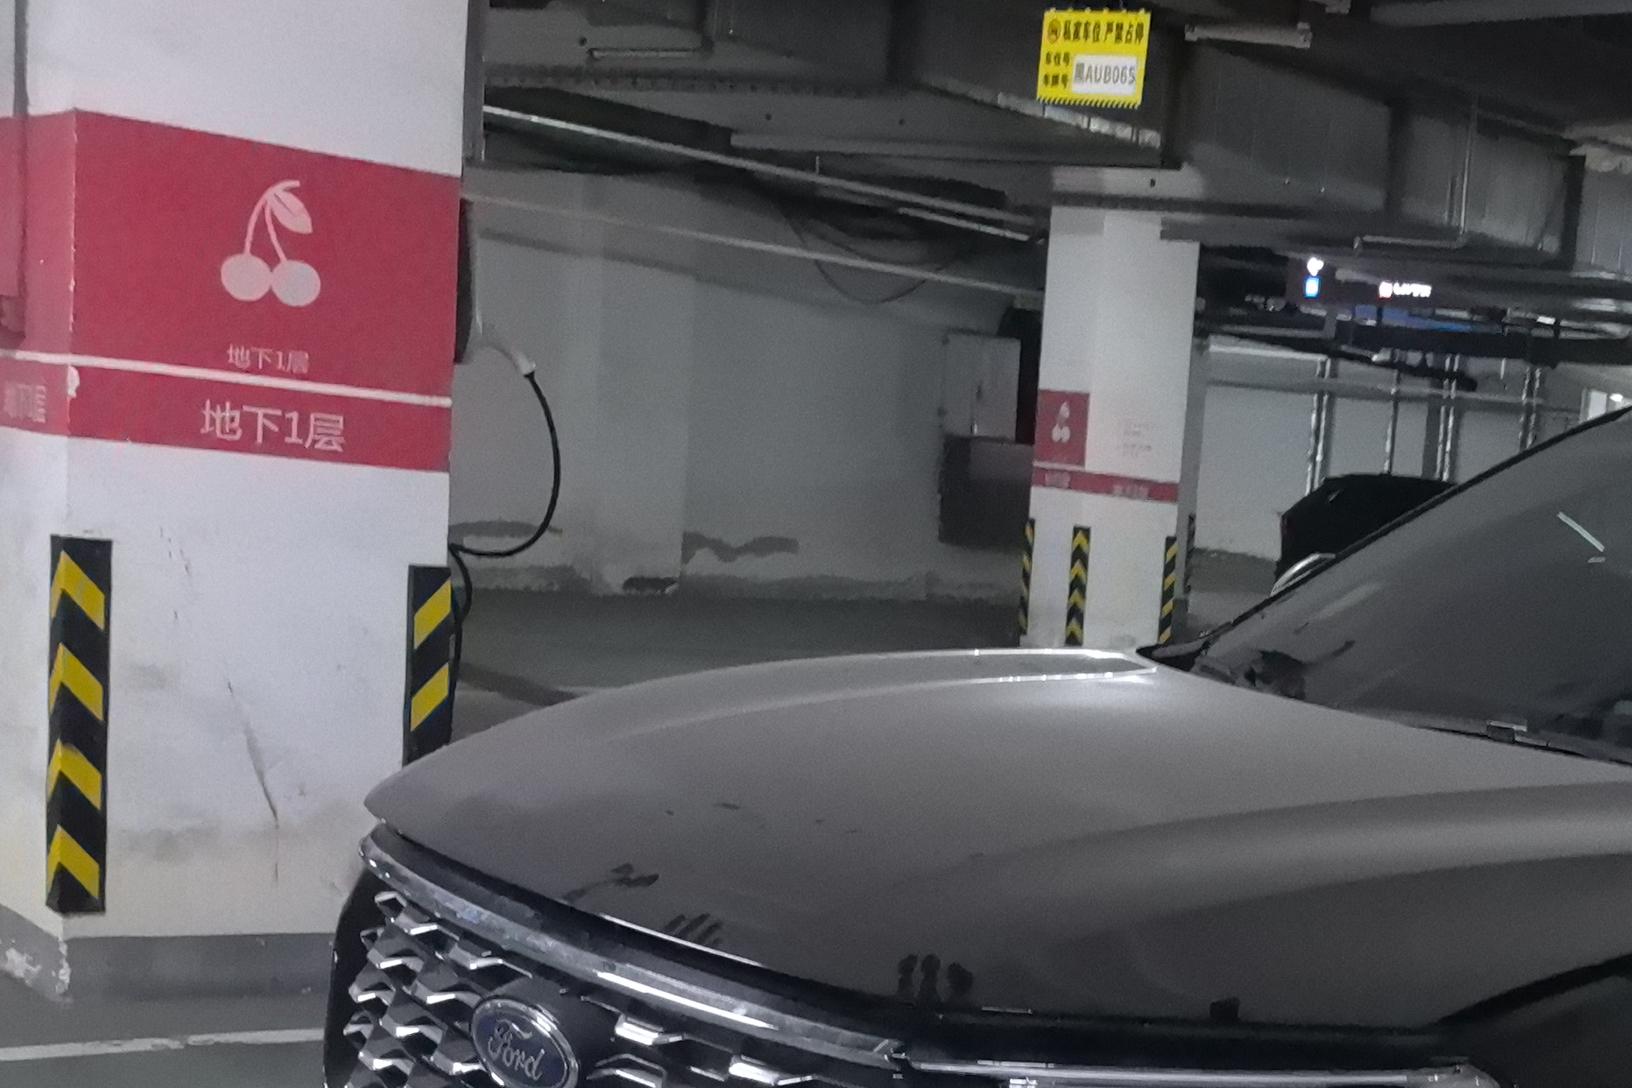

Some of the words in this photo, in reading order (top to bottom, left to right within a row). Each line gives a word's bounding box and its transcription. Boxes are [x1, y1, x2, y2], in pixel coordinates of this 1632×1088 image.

[227, 343, 309, 374] 地下1层
[201, 399, 345, 452] 地下1层
[488, 1019, 544, 1081] Ford
